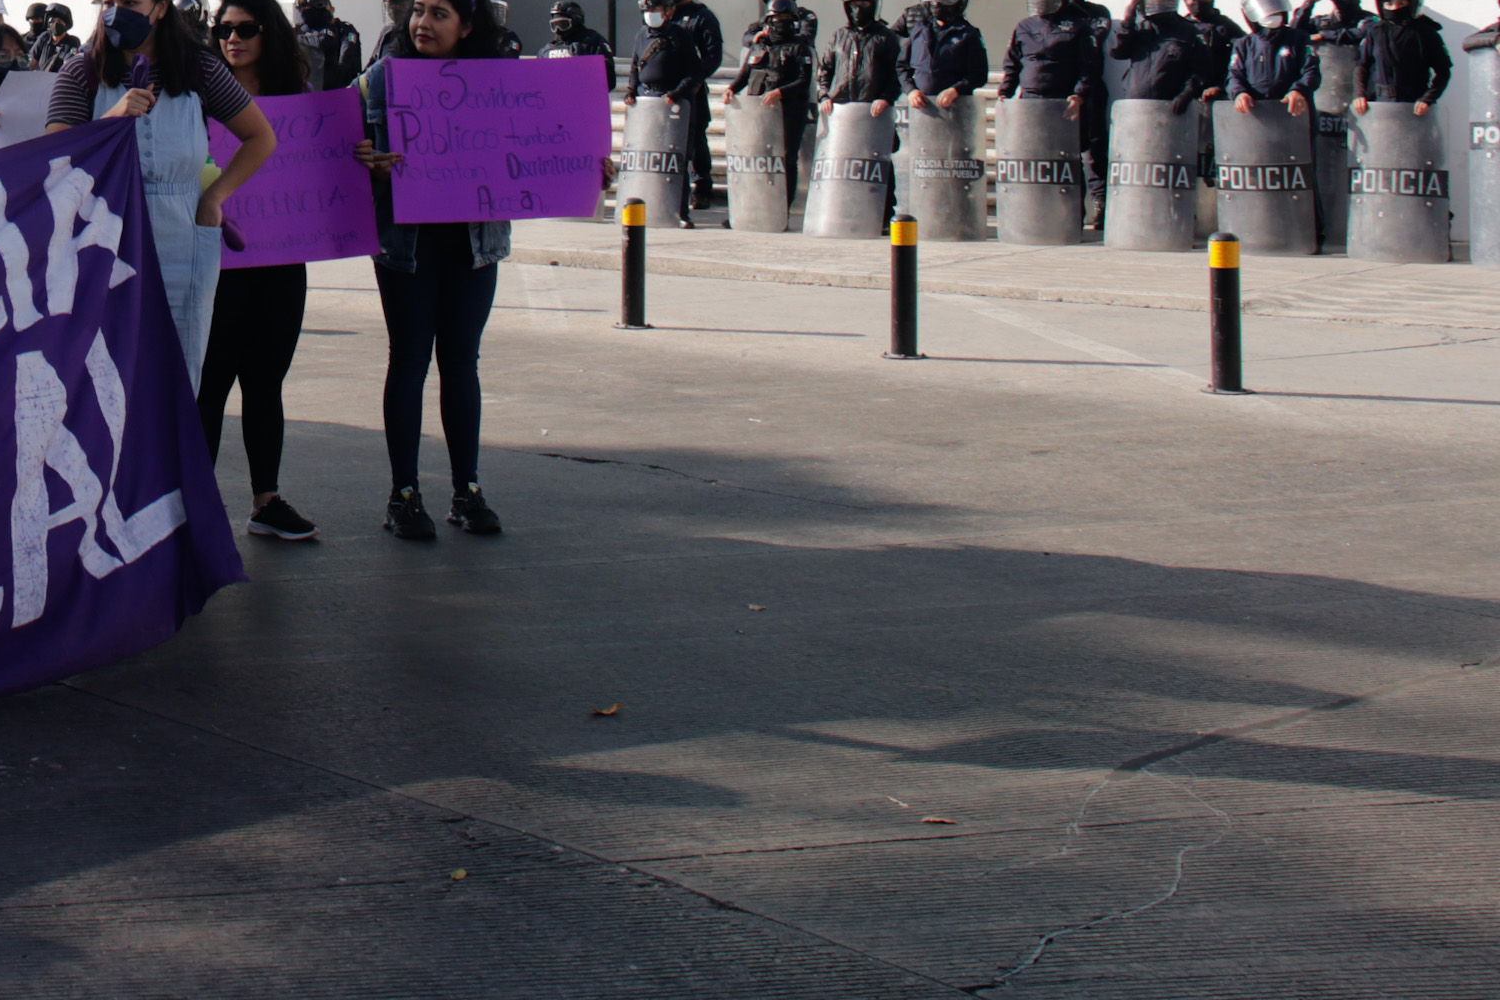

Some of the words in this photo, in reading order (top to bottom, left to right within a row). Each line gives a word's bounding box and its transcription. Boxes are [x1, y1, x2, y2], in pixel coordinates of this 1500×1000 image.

[386, 58, 434, 110] Los
[437, 60, 546, 111] Servidores
[1319, 116, 1349, 132] ESTA
[621, 151, 679, 174] POLICIA
[727, 156, 786, 174] POLICIA
[813, 159, 883, 182] POLICIA
[914, 159, 942, 169] POLICIA
[943, 160, 980, 169] ESTATAL
[914, 168, 951, 179] PREVENTIVA
[951, 169, 980, 179] PUEBLA
[997, 160, 1074, 184] POLICIA
[1109, 162, 1190, 188] POLICIA
[1218, 166, 1308, 190] POLICIA
[1351, 168, 1443, 196] POLICIA
[221, 184, 349, 220] VIOLENCIA
